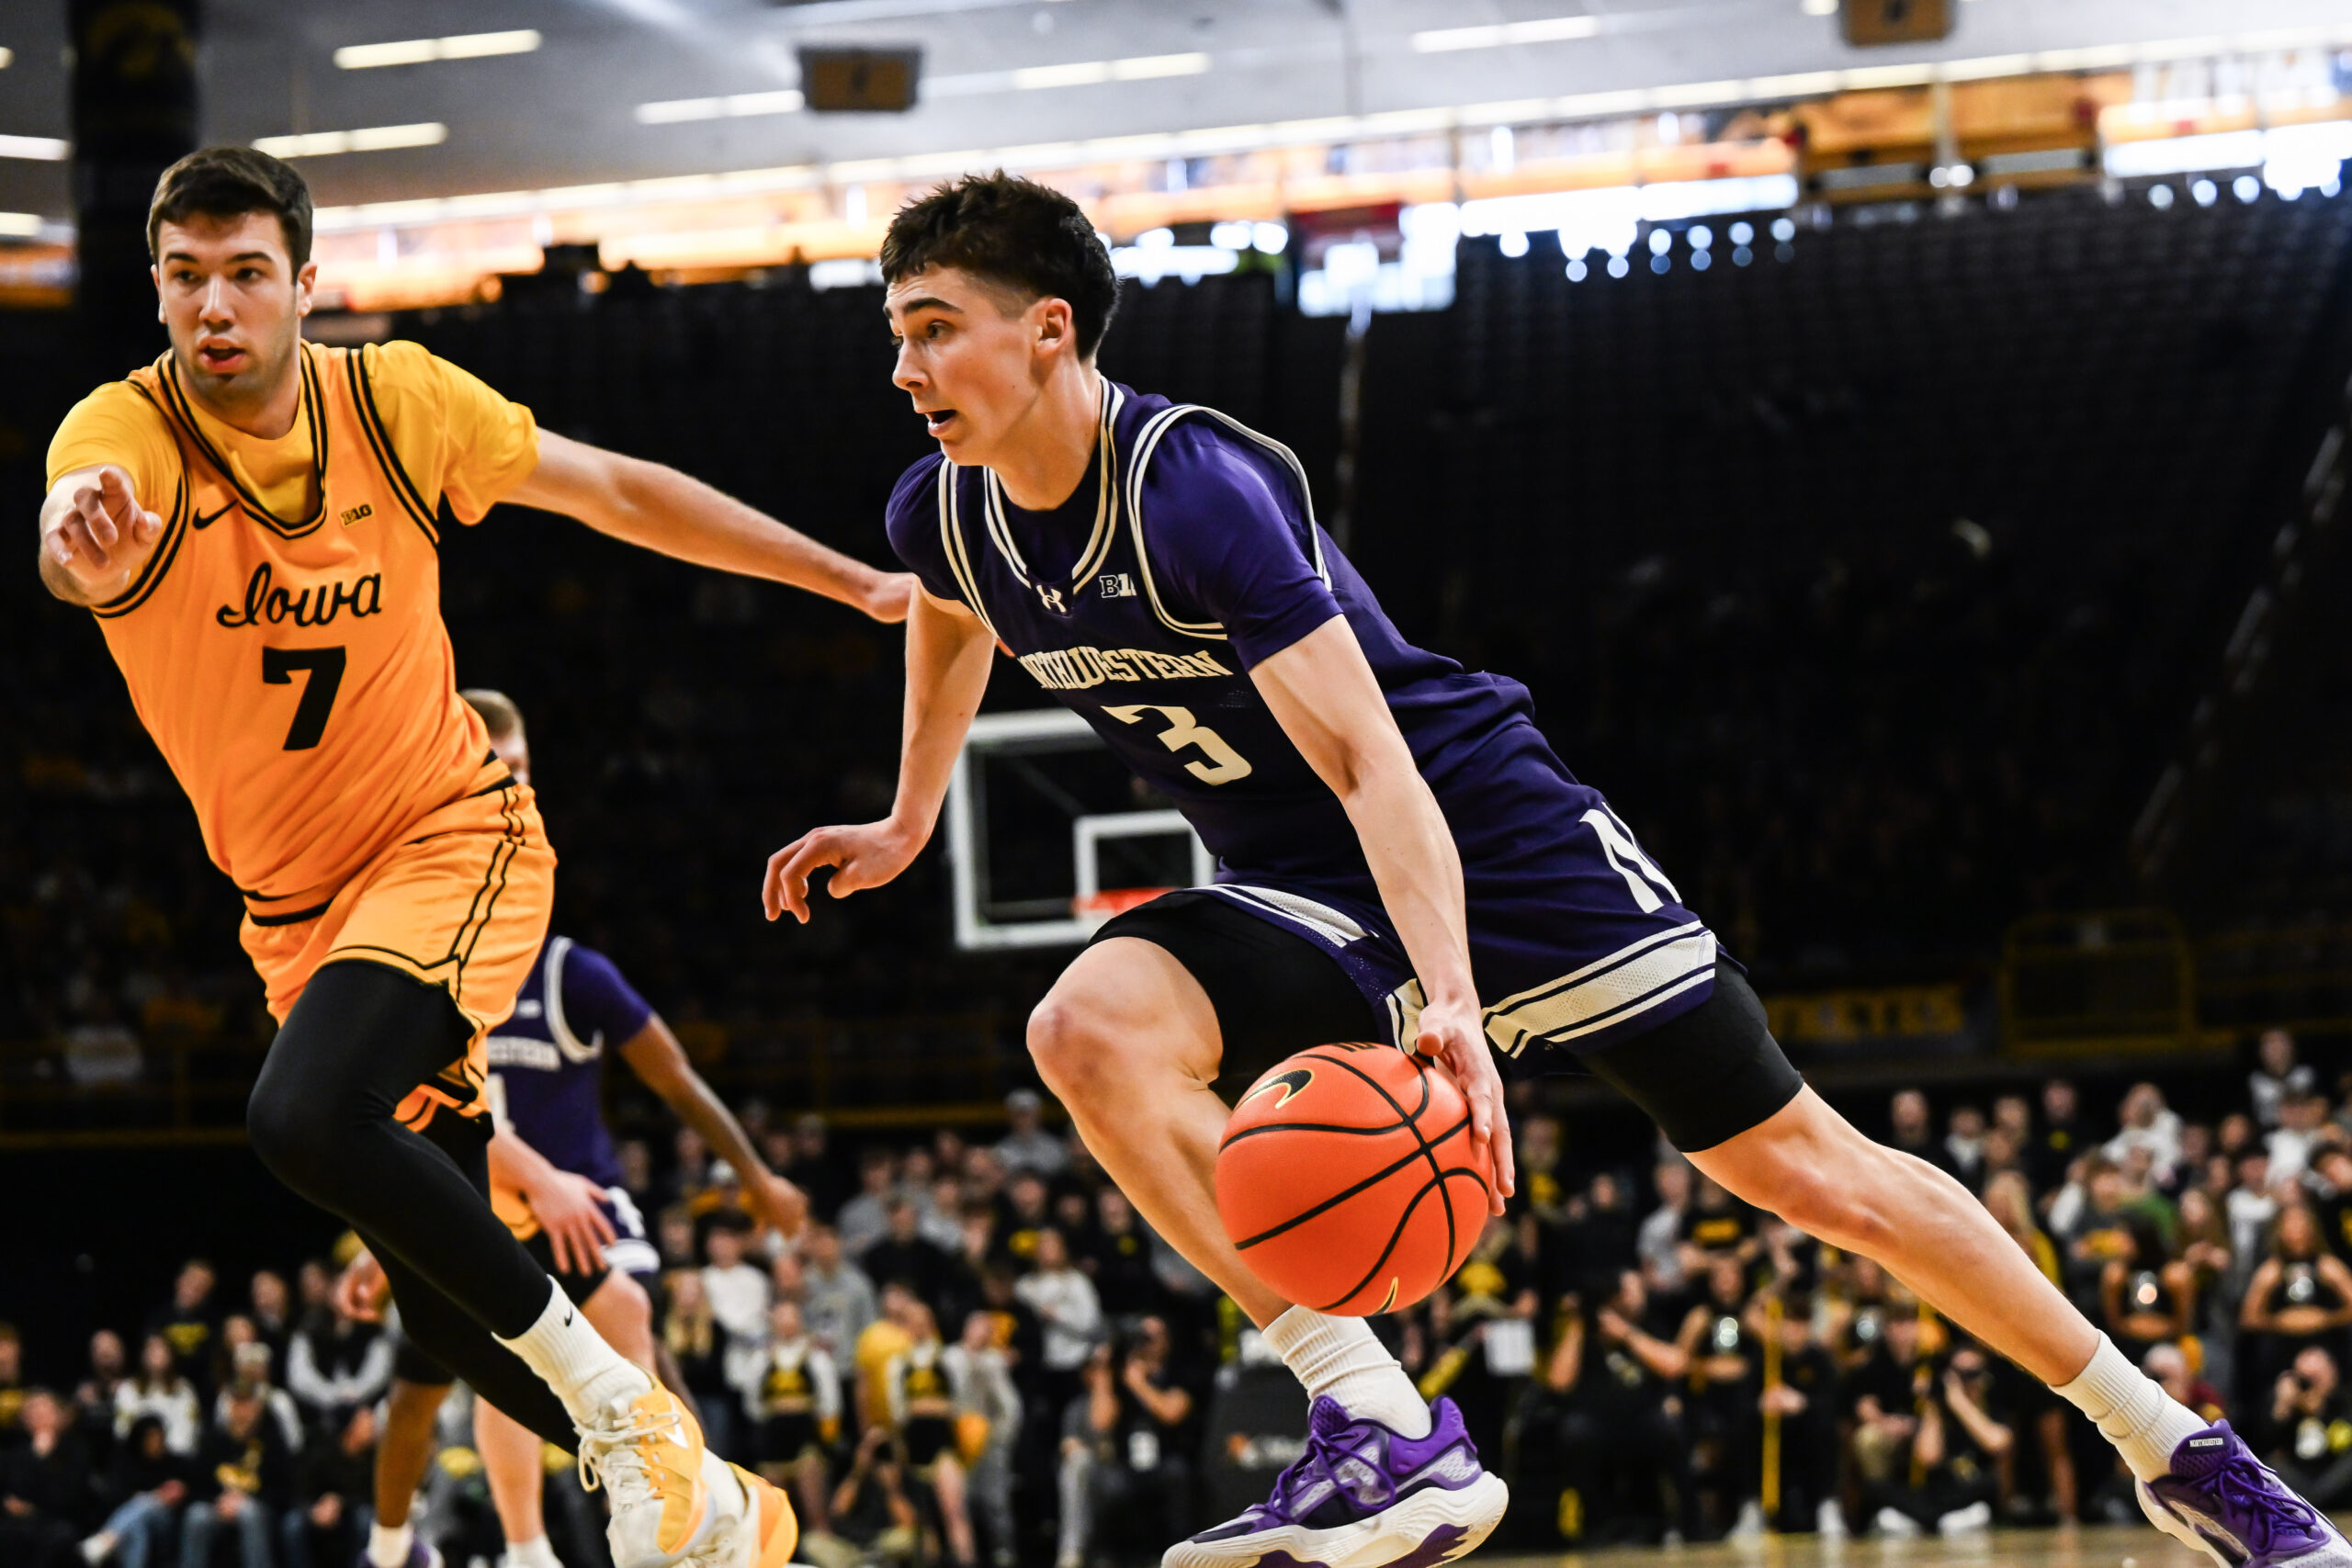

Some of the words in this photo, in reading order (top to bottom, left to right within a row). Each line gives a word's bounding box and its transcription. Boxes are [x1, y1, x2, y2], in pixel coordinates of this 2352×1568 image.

[216, 561, 382, 628] Iowa
[262, 645, 346, 751] 7
[1100, 704, 1253, 786] 3
